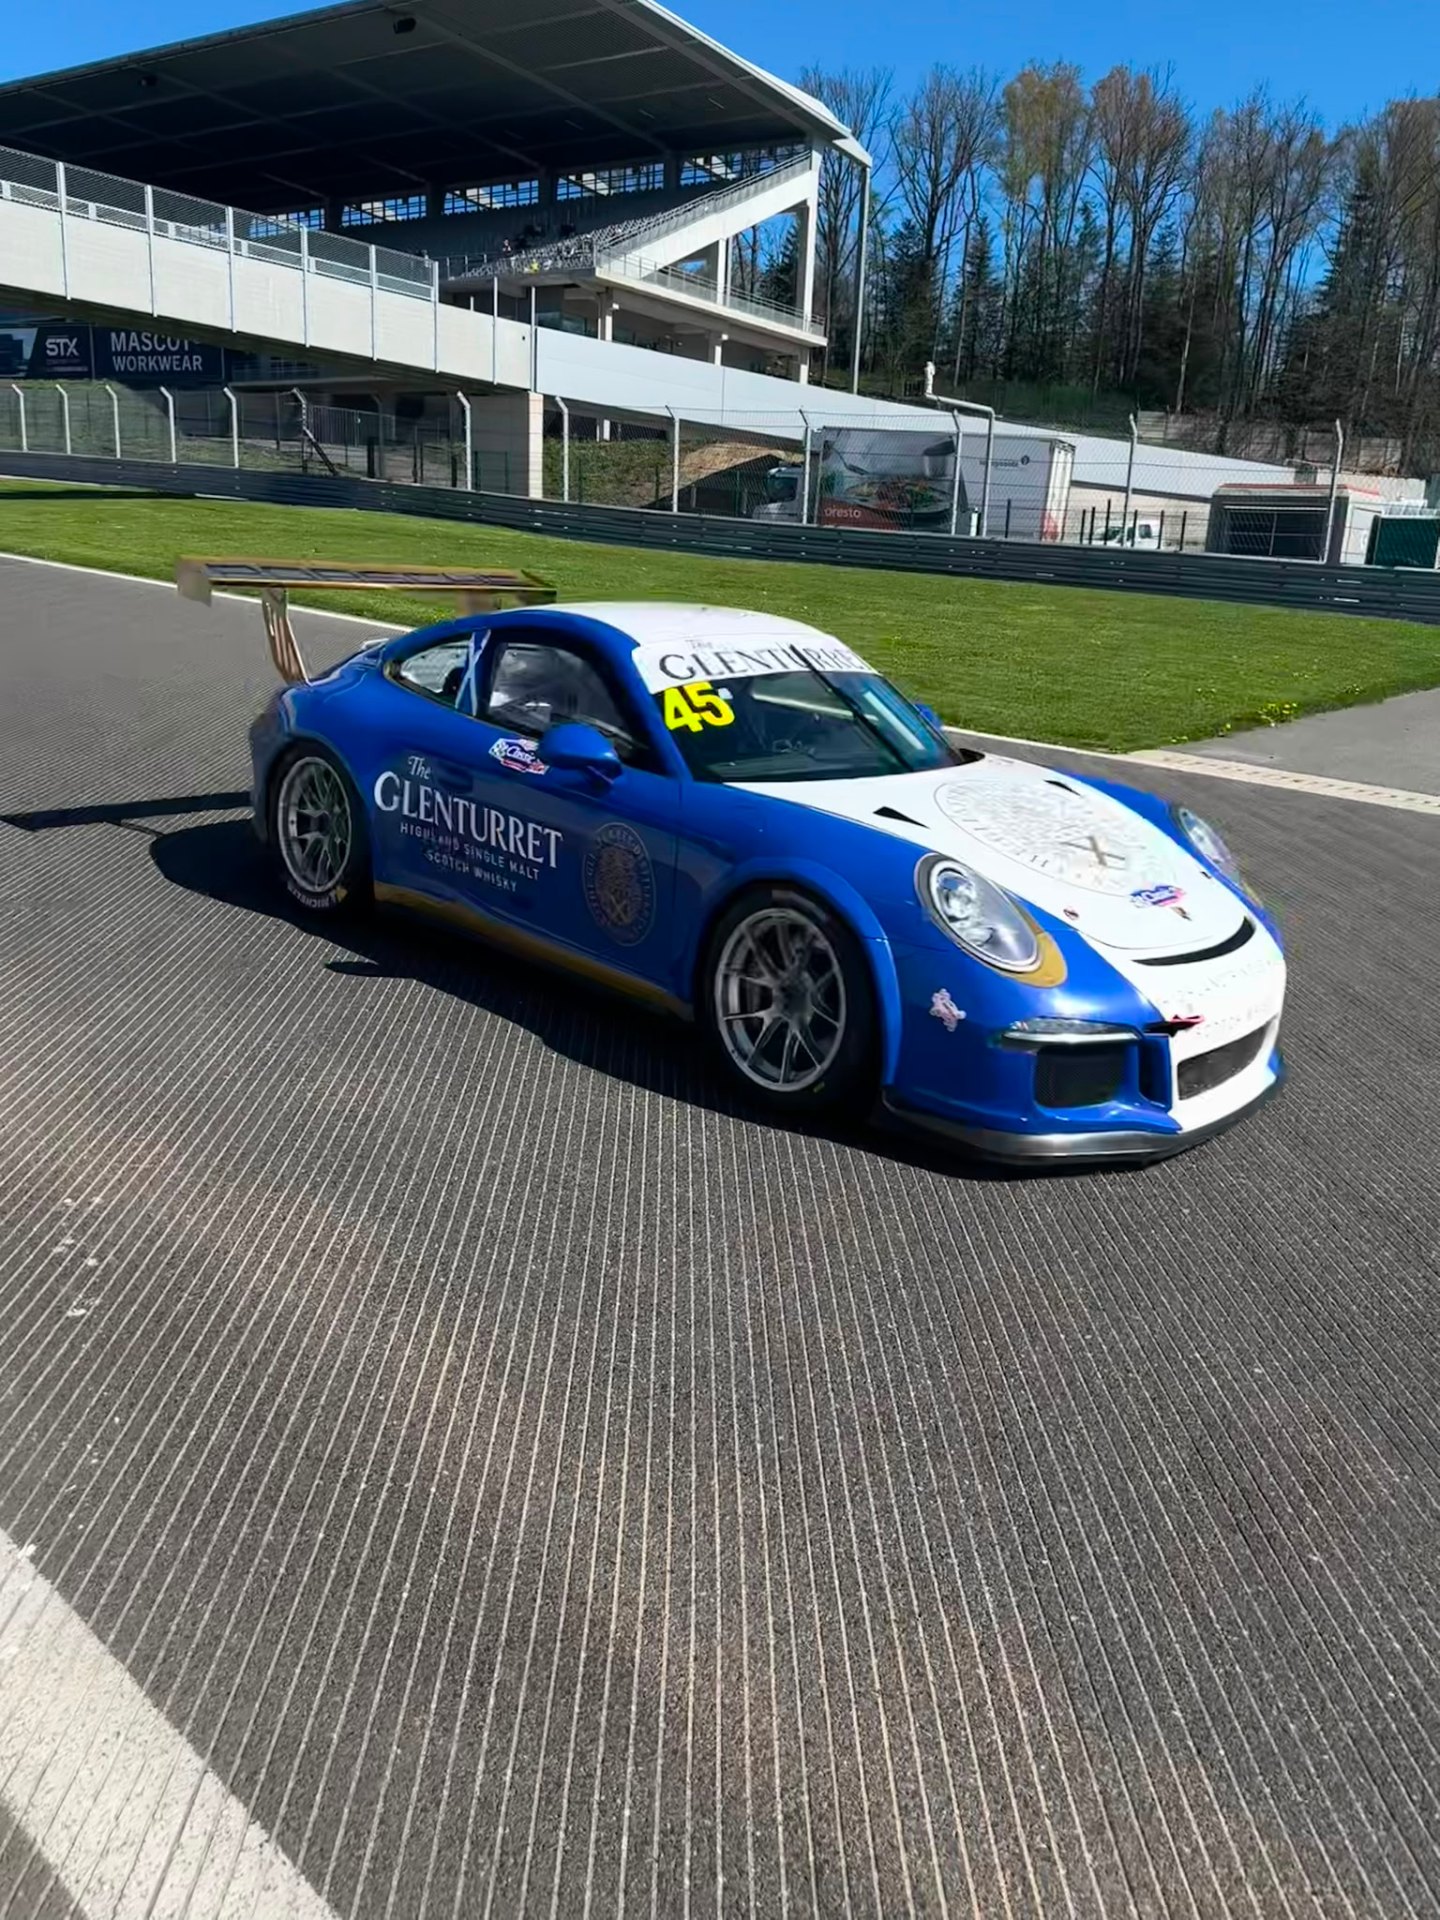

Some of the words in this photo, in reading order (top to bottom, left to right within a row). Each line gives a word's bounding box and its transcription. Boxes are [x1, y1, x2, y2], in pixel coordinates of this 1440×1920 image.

[45, 337, 79, 357] STX
[112, 355, 203, 372] WORKWEAR
[664, 680, 735, 733] 45
[408, 756, 432, 779] The
[374, 771, 564, 868] GLENTURRET
[425, 849, 469, 873] SCOTCH
[474, 868, 517, 892] WHISKY
[464, 843, 504, 868] SINGLE
[509, 860, 539, 881] MALT
